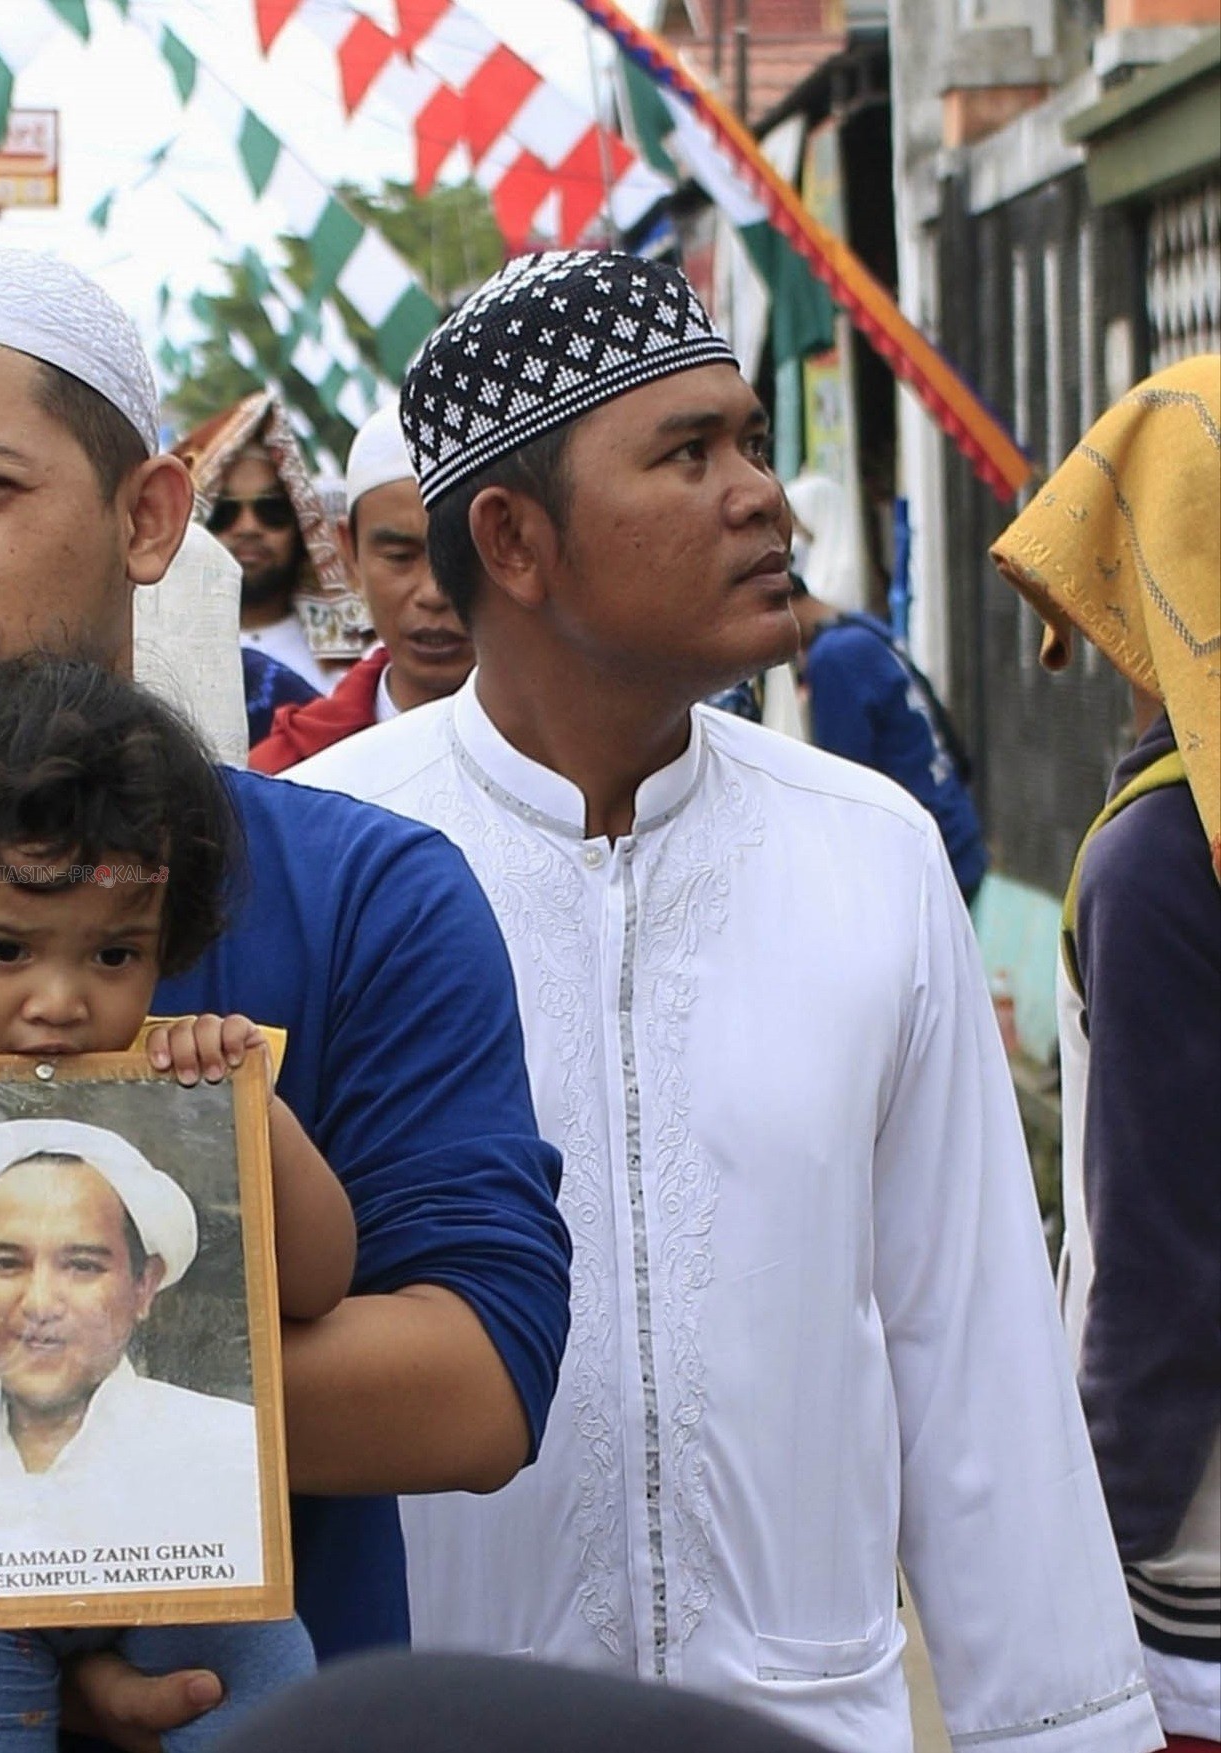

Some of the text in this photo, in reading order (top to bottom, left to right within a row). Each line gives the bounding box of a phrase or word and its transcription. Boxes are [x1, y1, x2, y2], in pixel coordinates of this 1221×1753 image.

[93, 1546, 151, 1563] ZAINI
[156, 1543, 225, 1560] GHANI
[103, 1563, 235, 1584] MARTAPURA)
